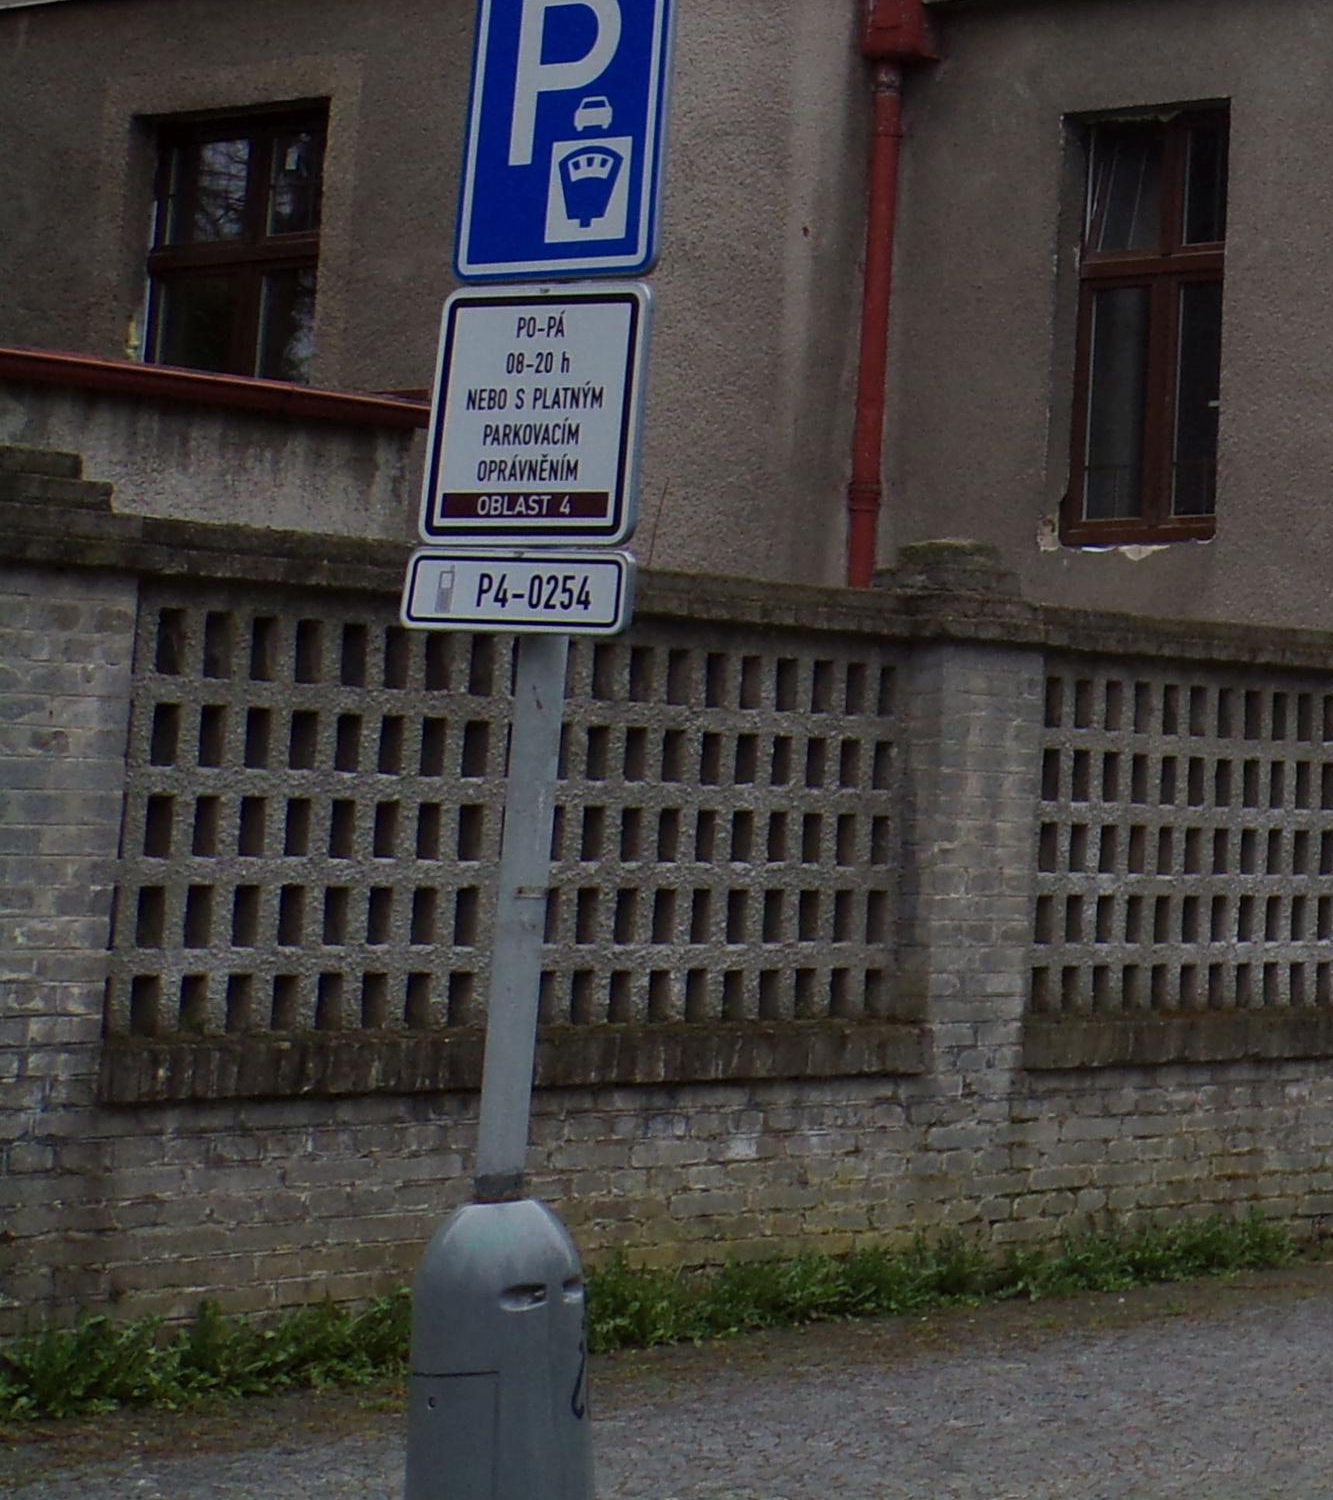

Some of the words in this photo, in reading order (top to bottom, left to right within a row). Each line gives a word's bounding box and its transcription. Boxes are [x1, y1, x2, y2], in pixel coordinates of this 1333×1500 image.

[516, 311, 565, 339] PO-PÁ
[506, 351, 554, 375] 08-20
[560, 352, 570, 374] h
[466, 387, 508, 411] NEBO
[515, 388, 526, 410] S
[532, 380, 604, 410] PLATNÝM
[482, 417, 581, 447] PARKOVACÍM
[476, 453, 579, 483] OPRÁVNĚNÍM
[476, 494, 552, 516] OBLAST
[559, 495, 571, 515] 4
[475, 572, 592, 611] P4-0254
